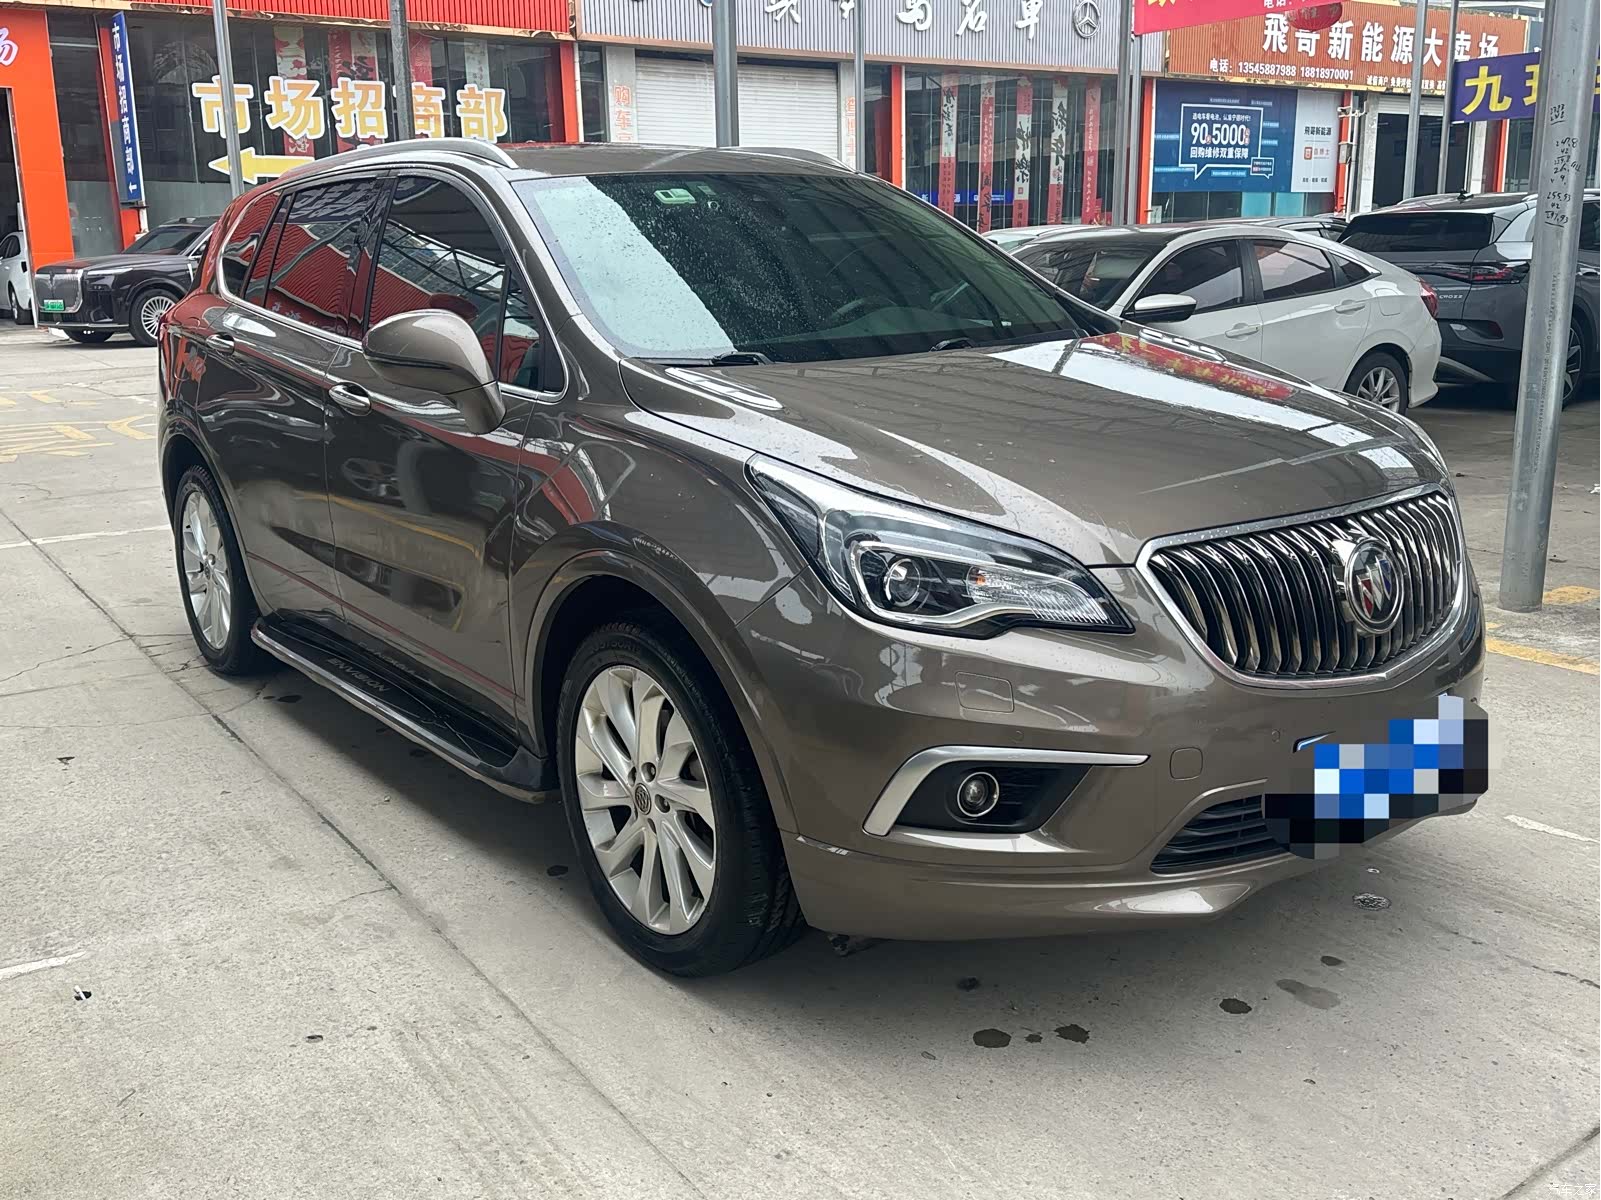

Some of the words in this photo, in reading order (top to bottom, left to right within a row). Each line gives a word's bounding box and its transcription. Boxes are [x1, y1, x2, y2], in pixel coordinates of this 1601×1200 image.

[1238, 61, 1296, 77] 13545887988
[1300, 66, 1353, 81] 18818970001
[192, 75, 507, 143] 市场招商部
